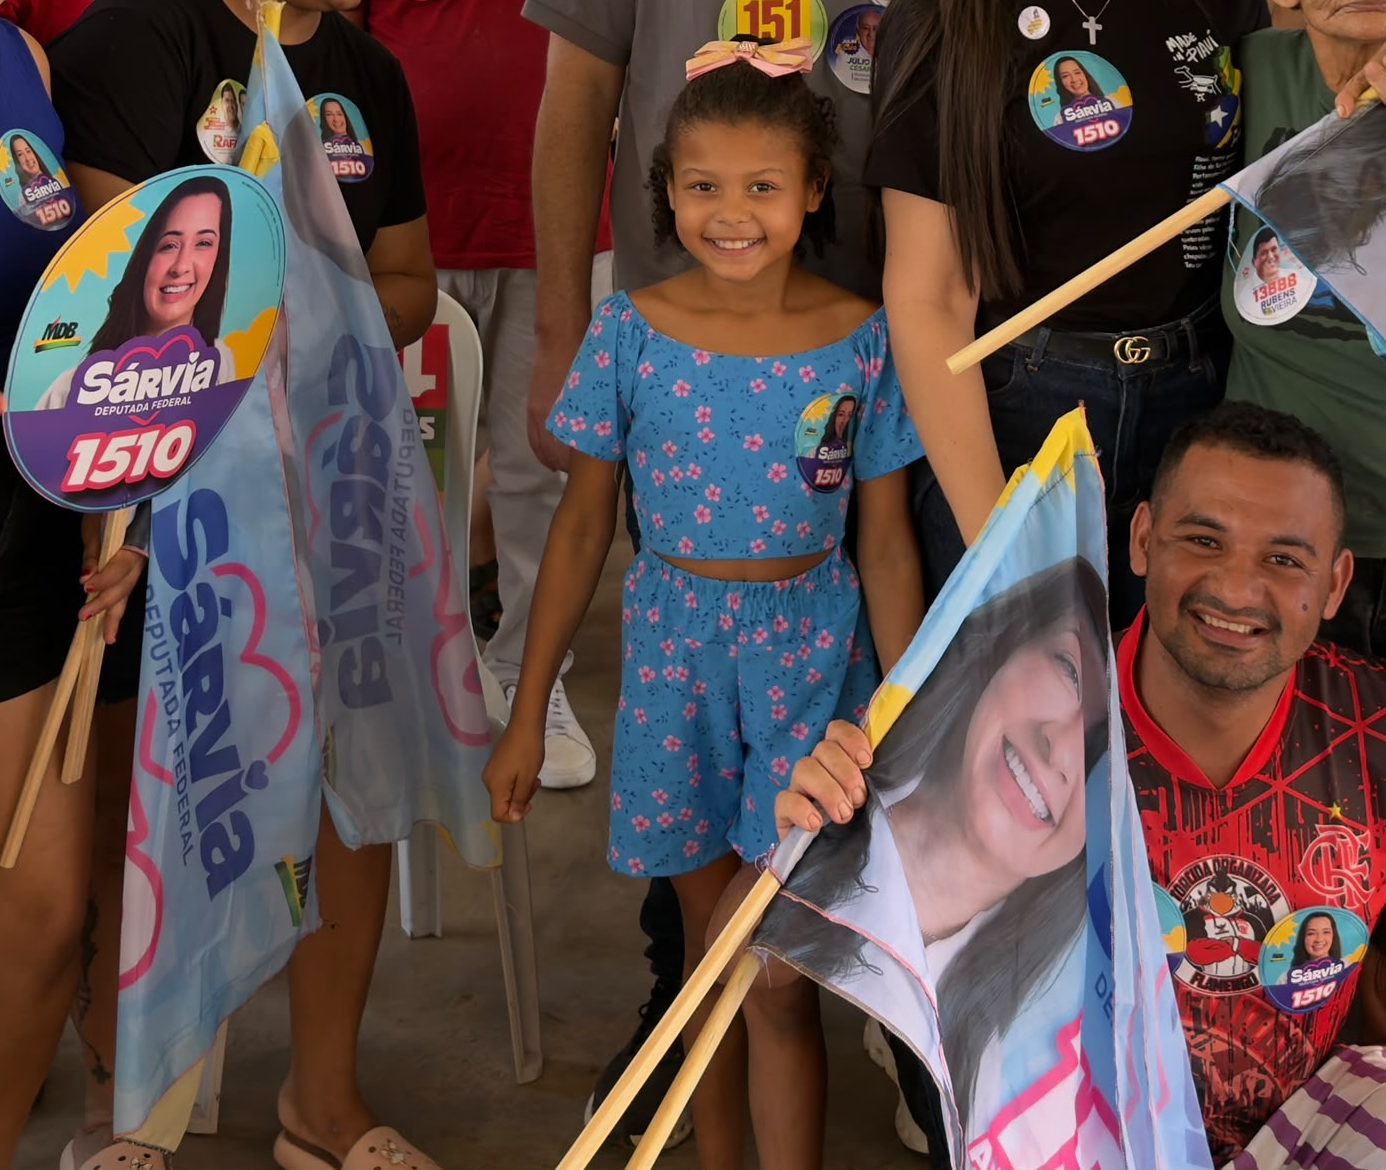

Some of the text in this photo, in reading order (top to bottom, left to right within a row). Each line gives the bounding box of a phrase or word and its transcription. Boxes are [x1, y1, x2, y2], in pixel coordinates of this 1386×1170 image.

[1166, 32, 1198, 53] MADE
[1185, 29, 1220, 63] PIAUÍ
[1063, 98, 1114, 123] Sárvia
[1071, 118, 1120, 145] 1510
[330, 160, 366, 176] 1510
[24, 179, 62, 202] Sárvia
[35, 199, 70, 225] 1510
[1253, 273, 1299, 302] 13888
[1260, 289, 1297, 309] RUBENS
[1271, 297, 1299, 316] VIEIRA
[77, 350, 215, 406] Sárvia
[94, 394, 192, 417] DEPUTADA FEDERAL
[68, 421, 193, 488] 1510
[815, 468, 843, 485] 1510
[152, 486, 271, 901] Sárvia
[168, 740, 195, 867] FEDERAL
[1170, 858, 1282, 906] TORCIDA ORGANIZADA
[1190, 971, 1260, 993] FLAMENGO
[1290, 961, 1343, 985] Sárvia
[1292, 981, 1337, 1008] 1510
